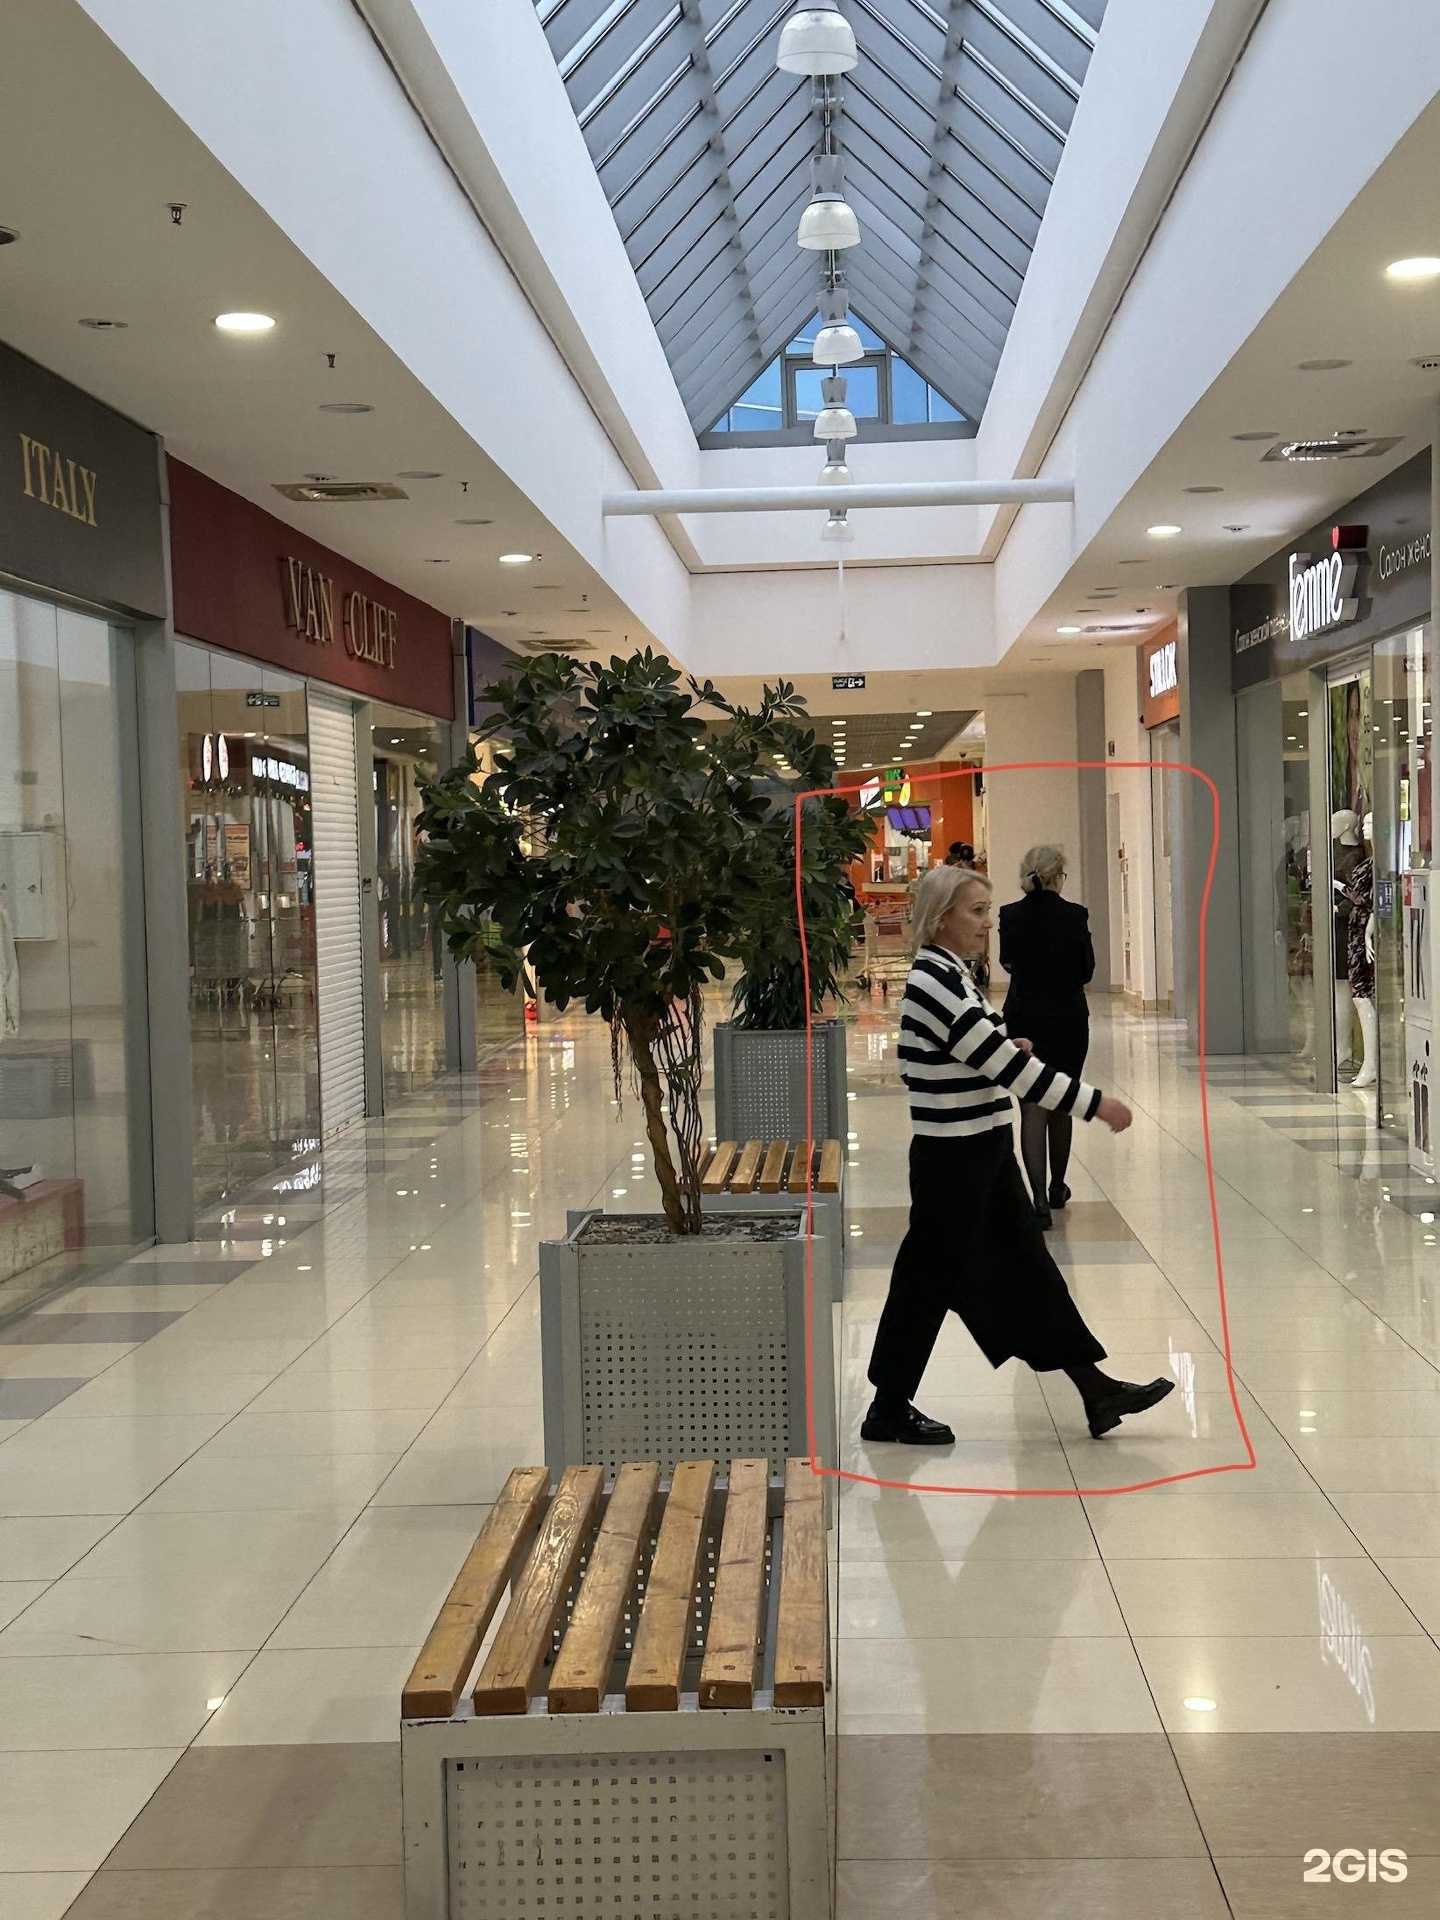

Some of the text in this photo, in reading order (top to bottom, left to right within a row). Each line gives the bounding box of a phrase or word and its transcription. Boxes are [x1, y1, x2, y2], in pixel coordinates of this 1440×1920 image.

[19, 432, 97, 527] ITALY
[287, 556, 397, 669] VAN CLIFF
